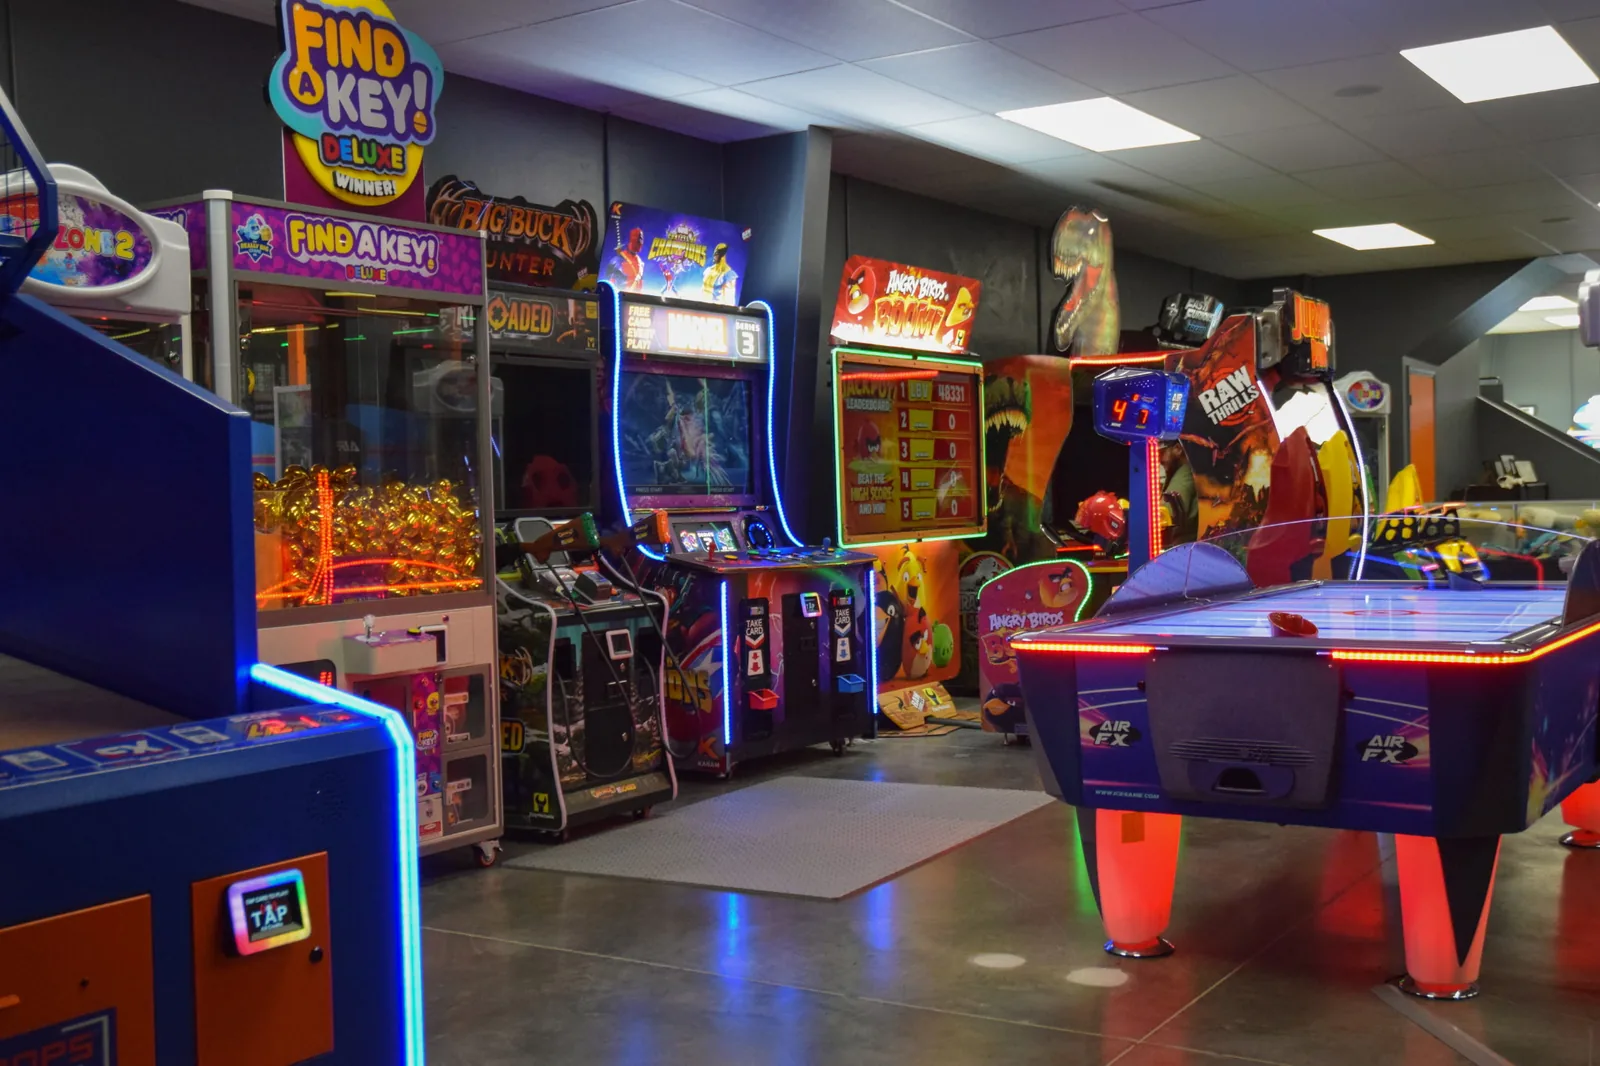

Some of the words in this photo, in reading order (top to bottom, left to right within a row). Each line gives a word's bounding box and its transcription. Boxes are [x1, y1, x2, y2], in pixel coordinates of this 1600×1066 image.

[292, 3, 405, 78] FIND
[326, 70, 427, 134] KEY!
[323, 136, 404, 170] DELUXE
[335, 171, 397, 196] WINNER!
[458, 199, 506, 233] BIG
[508, 207, 573, 258] BUCK
[54, 224, 114, 256] ZONE
[115, 231, 135, 260] 2
[289, 220, 353, 254] FIND
[357, 229, 376, 257] A
[380, 229, 435, 269] KEY!
[648, 237, 707, 267] CHAMPIONS
[486, 250, 555, 275] UNTER
[346, 265, 387, 281] DELUXE
[886, 270, 919, 296] ANGRY
[918, 277, 948, 300] BIRDS
[628, 305, 650, 317] FREE
[876, 298, 946, 341] BOOM!
[628, 317, 651, 328] CARD
[736, 321, 760, 332] SERIES
[627, 328, 655, 339] EVERY
[741, 332, 754, 354] 3
[900, 382, 906, 398] 1
[938, 384, 965, 402] 48331
[1198, 366, 1251, 413] RAW
[1113, 399, 1128, 421] 4
[1208, 385, 1260, 425] THRILLS
[901, 411, 907, 428] 2
[948, 413, 956, 430] 0
[1140, 409, 1149, 424] 7
[901, 441, 908, 458] 3
[949, 442, 957, 458] 0
[902, 471, 909, 488] 4
[903, 501, 910, 518] 5
[951, 500, 958, 515] 0
[835, 608, 850, 617] TAKE
[835, 616, 851, 625] CARD
[989, 613, 1026, 631] ANGRY
[1027, 611, 1064, 629] BIRDS
[746, 619, 762, 628] TAKE
[746, 627, 764, 636] CARD
[1100, 720, 1131, 732] AIR
[1095, 732, 1130, 747] FX
[1367, 734, 1405, 748] AIR
[1362, 748, 1403, 764] FX
[251, 903, 288, 928] TAP
